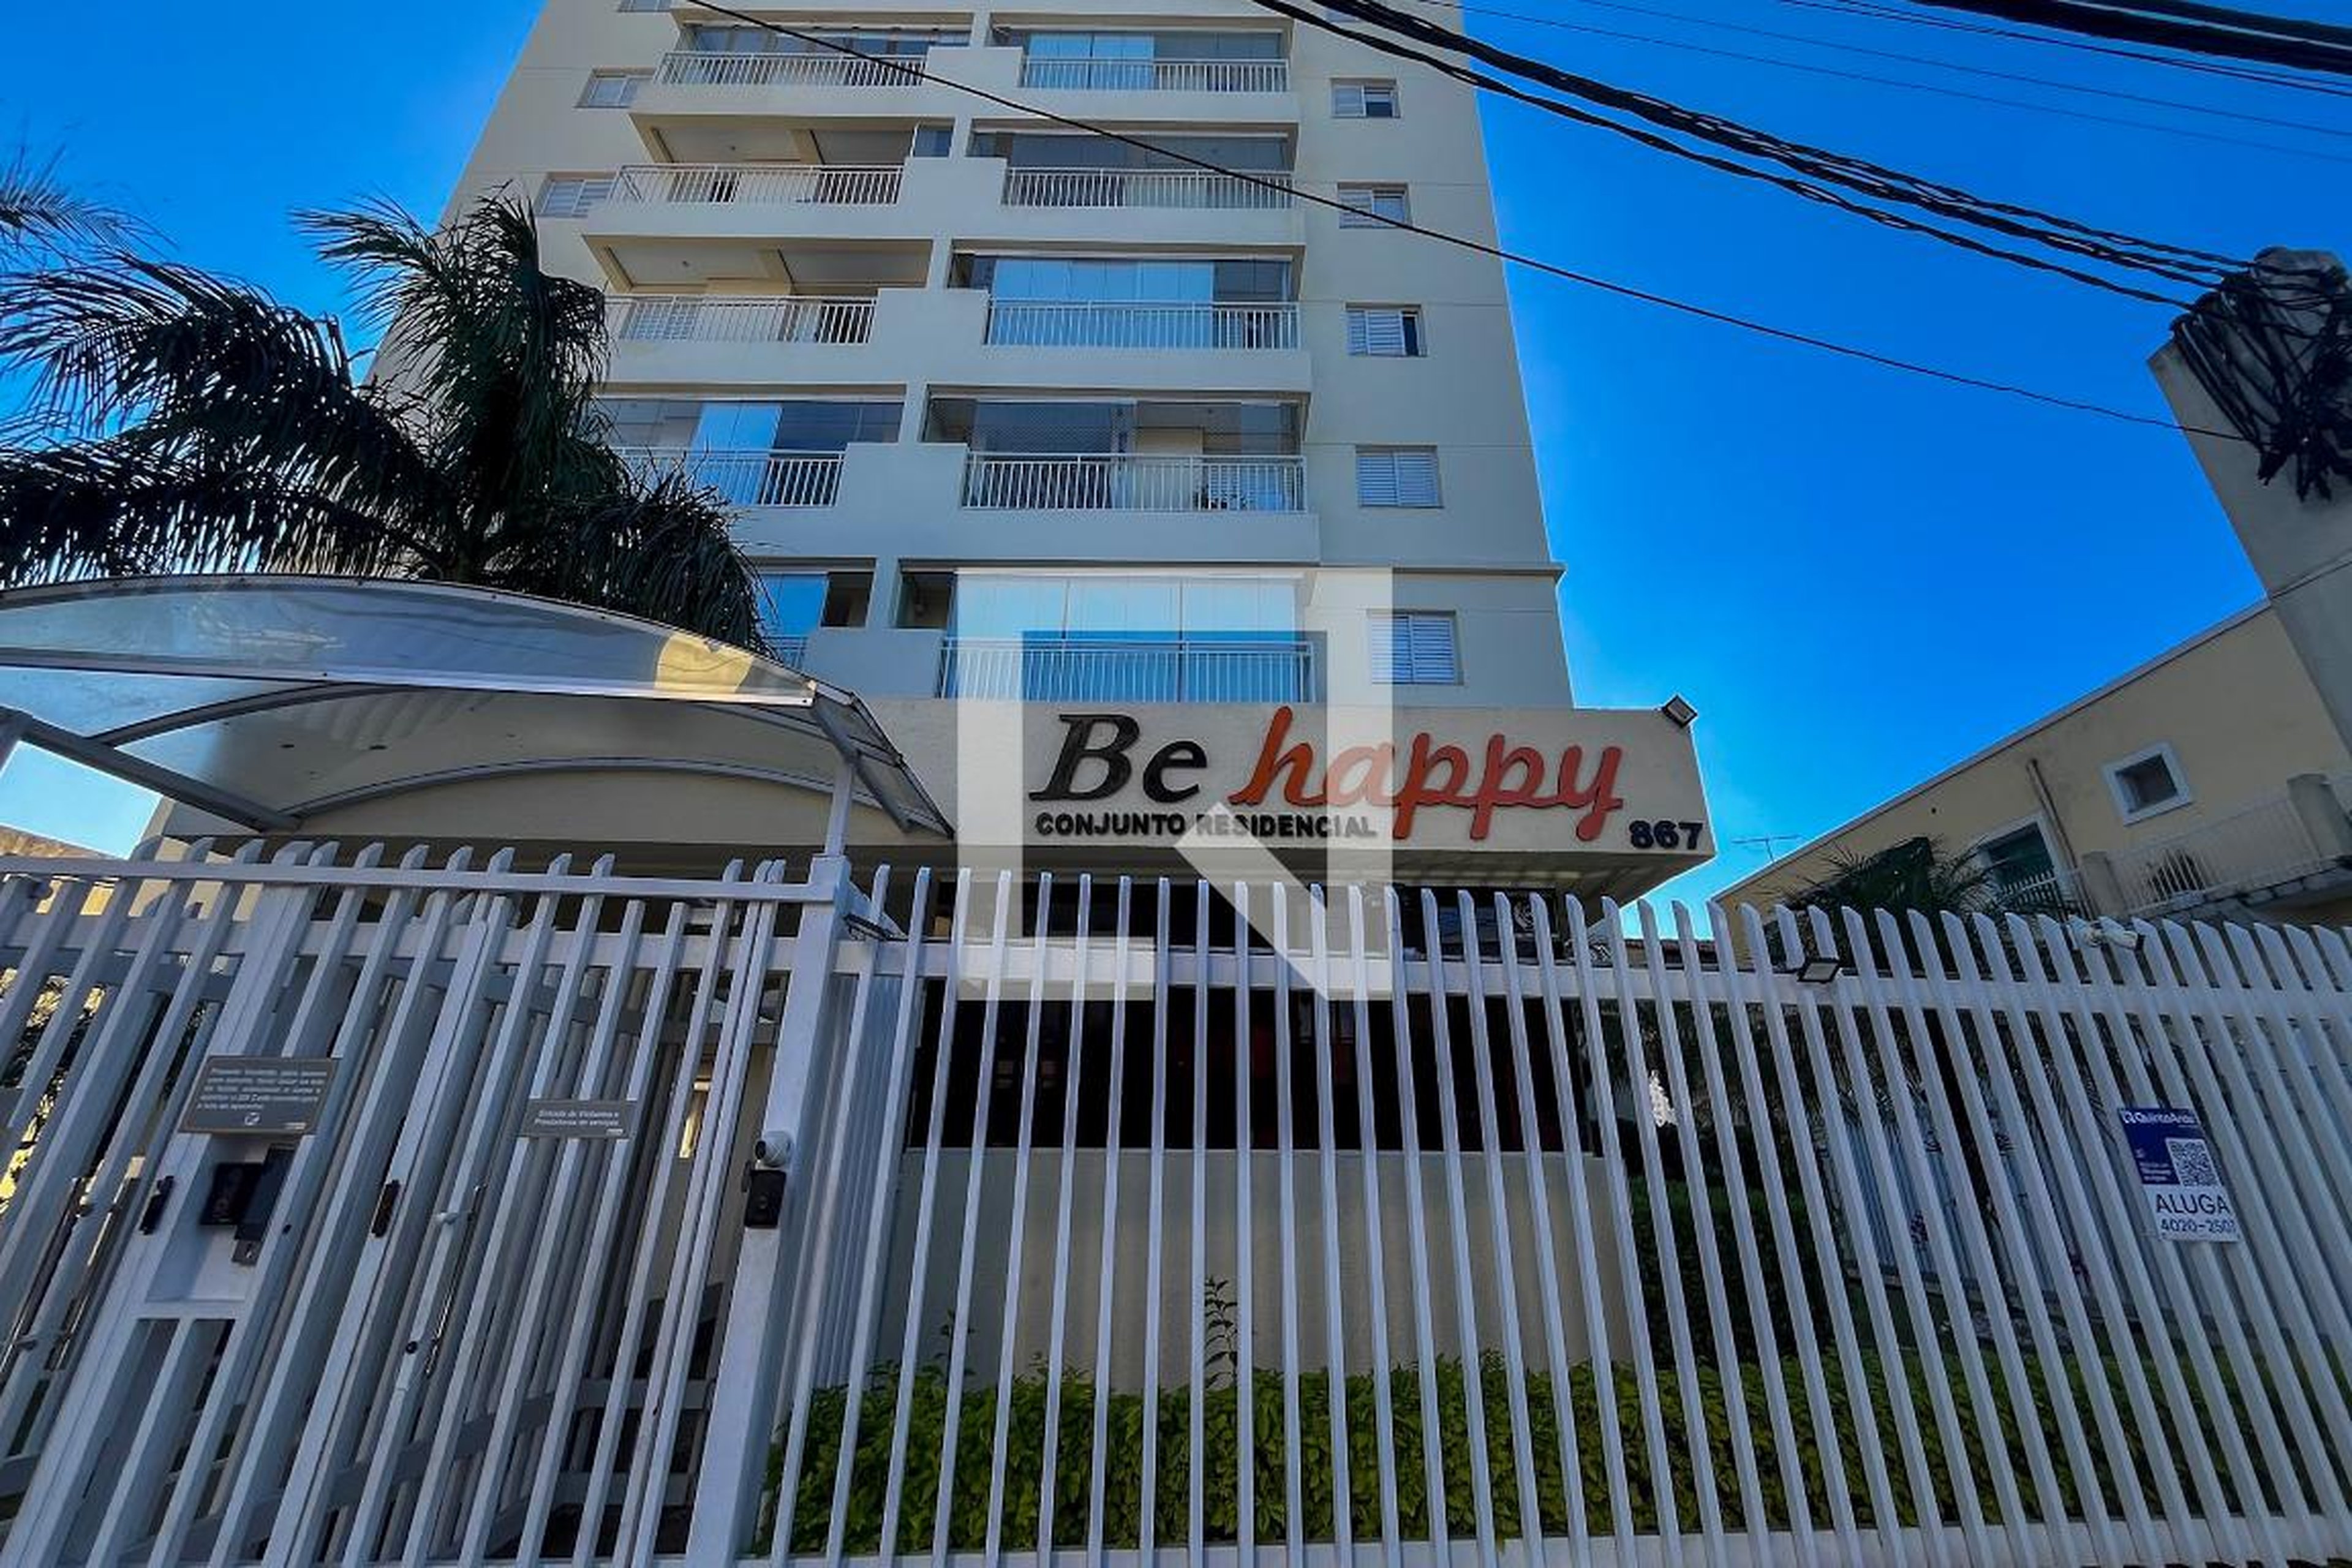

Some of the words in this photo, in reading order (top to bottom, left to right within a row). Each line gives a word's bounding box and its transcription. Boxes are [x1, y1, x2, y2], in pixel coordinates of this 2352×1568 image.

[1028, 714, 1207, 803] Be
[1227, 706, 1624, 841] happy
[1036, 813, 1185, 835] CONJUNTO
[1196, 813, 1378, 838] RESIDENCIAL
[1629, 820, 1704, 850] 867
[2156, 1194, 2231, 1215] ALUGA
